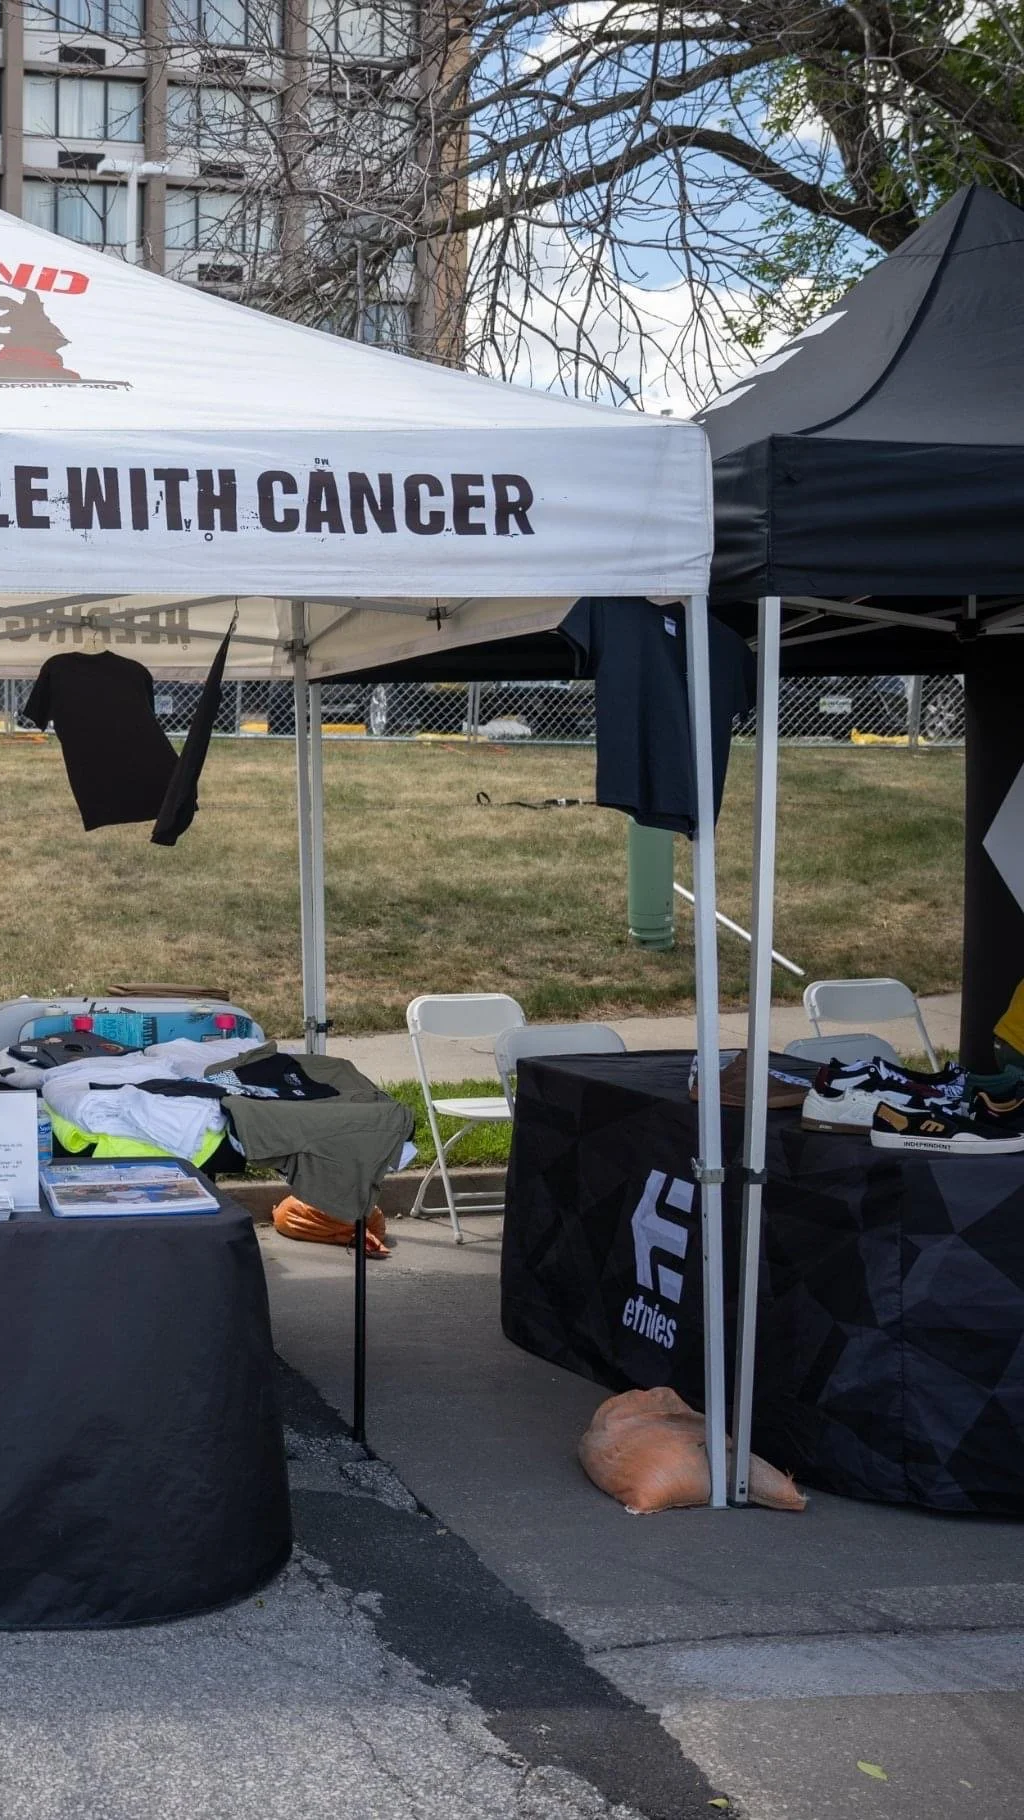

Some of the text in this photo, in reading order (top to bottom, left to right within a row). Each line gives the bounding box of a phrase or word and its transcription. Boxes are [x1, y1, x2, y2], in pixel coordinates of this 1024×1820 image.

[66, 466, 238, 532] WITH
[257, 468, 536, 536] CANCER
[903, 1141, 952, 1151] INDEPENDENT
[621, 1295, 677, 1350] etnies
